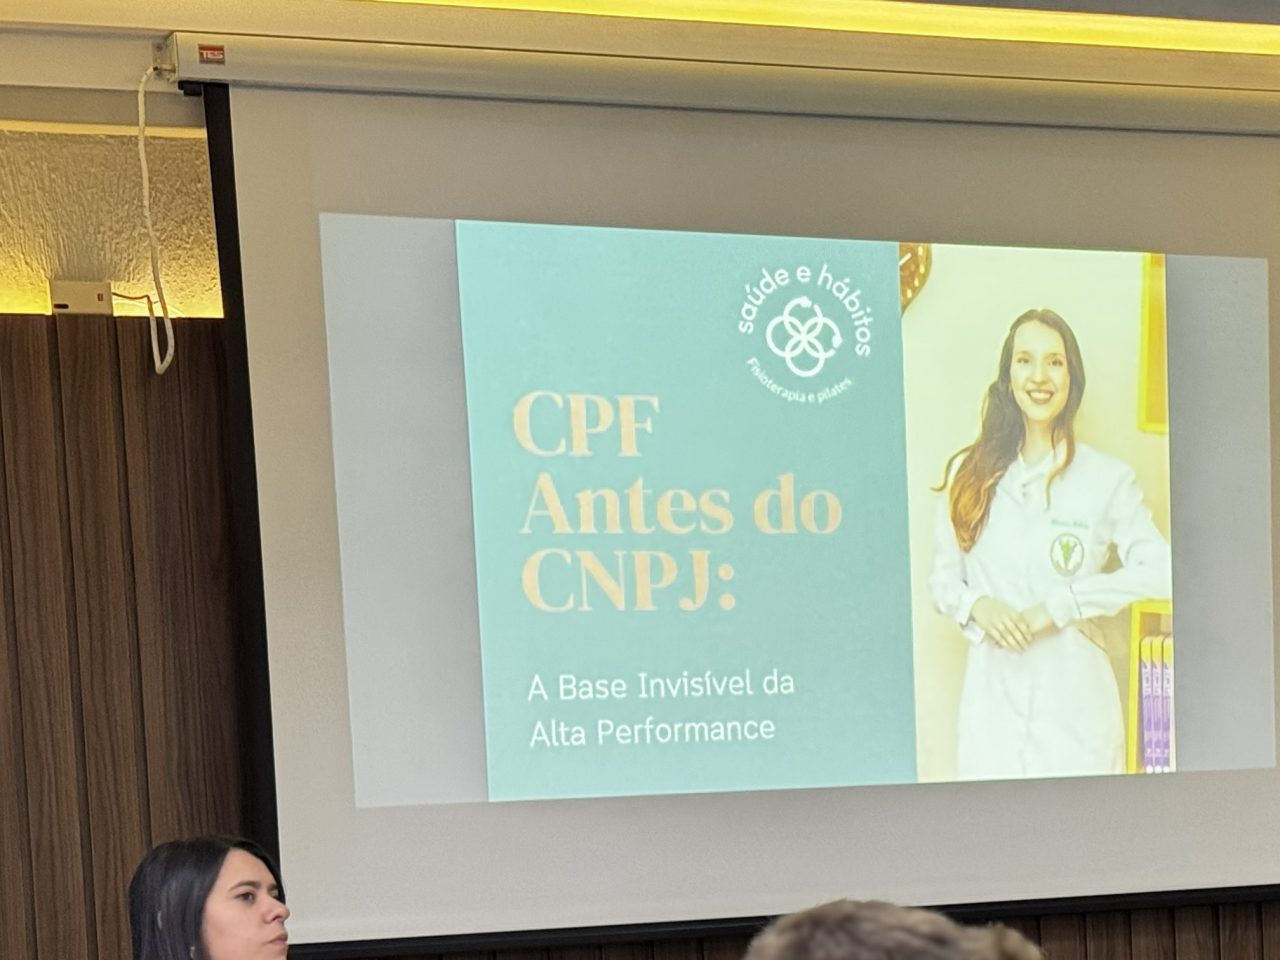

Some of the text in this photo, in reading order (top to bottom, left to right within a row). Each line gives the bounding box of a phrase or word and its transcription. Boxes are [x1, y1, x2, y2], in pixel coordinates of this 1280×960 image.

[738, 263, 873, 357] saúde e hábitos
[746, 356, 852, 404] Fisioterapia e pilates
[513, 389, 660, 457] CPF
[518, 471, 843, 535] Antes do
[521, 547, 736, 613] CNPJ:
[527, 667, 795, 702] A Base Invisível da
[529, 716, 776, 748] Alta Performance
